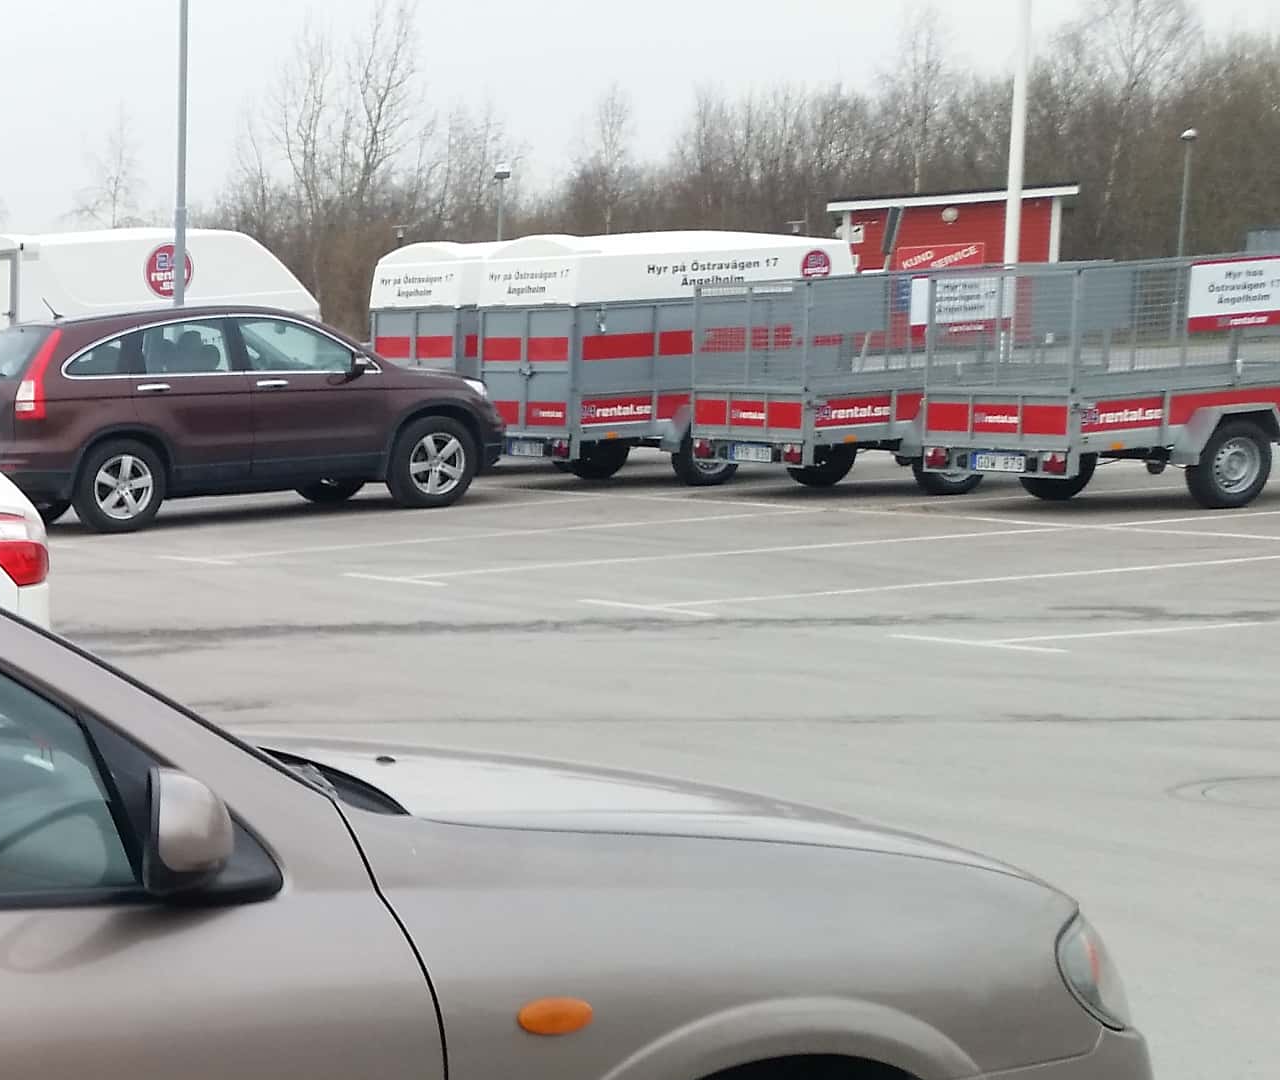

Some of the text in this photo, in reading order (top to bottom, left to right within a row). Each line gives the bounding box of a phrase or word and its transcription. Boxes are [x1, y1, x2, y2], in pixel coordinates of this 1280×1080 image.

[902, 250, 935, 269] KUND
[647, 257, 780, 275] Hyr på Östravägen 17
[1224, 269, 1263, 280] Hyr hos
[1208, 280, 1266, 292] Östravägen
[1217, 293, 1270, 305] Ängelholm
